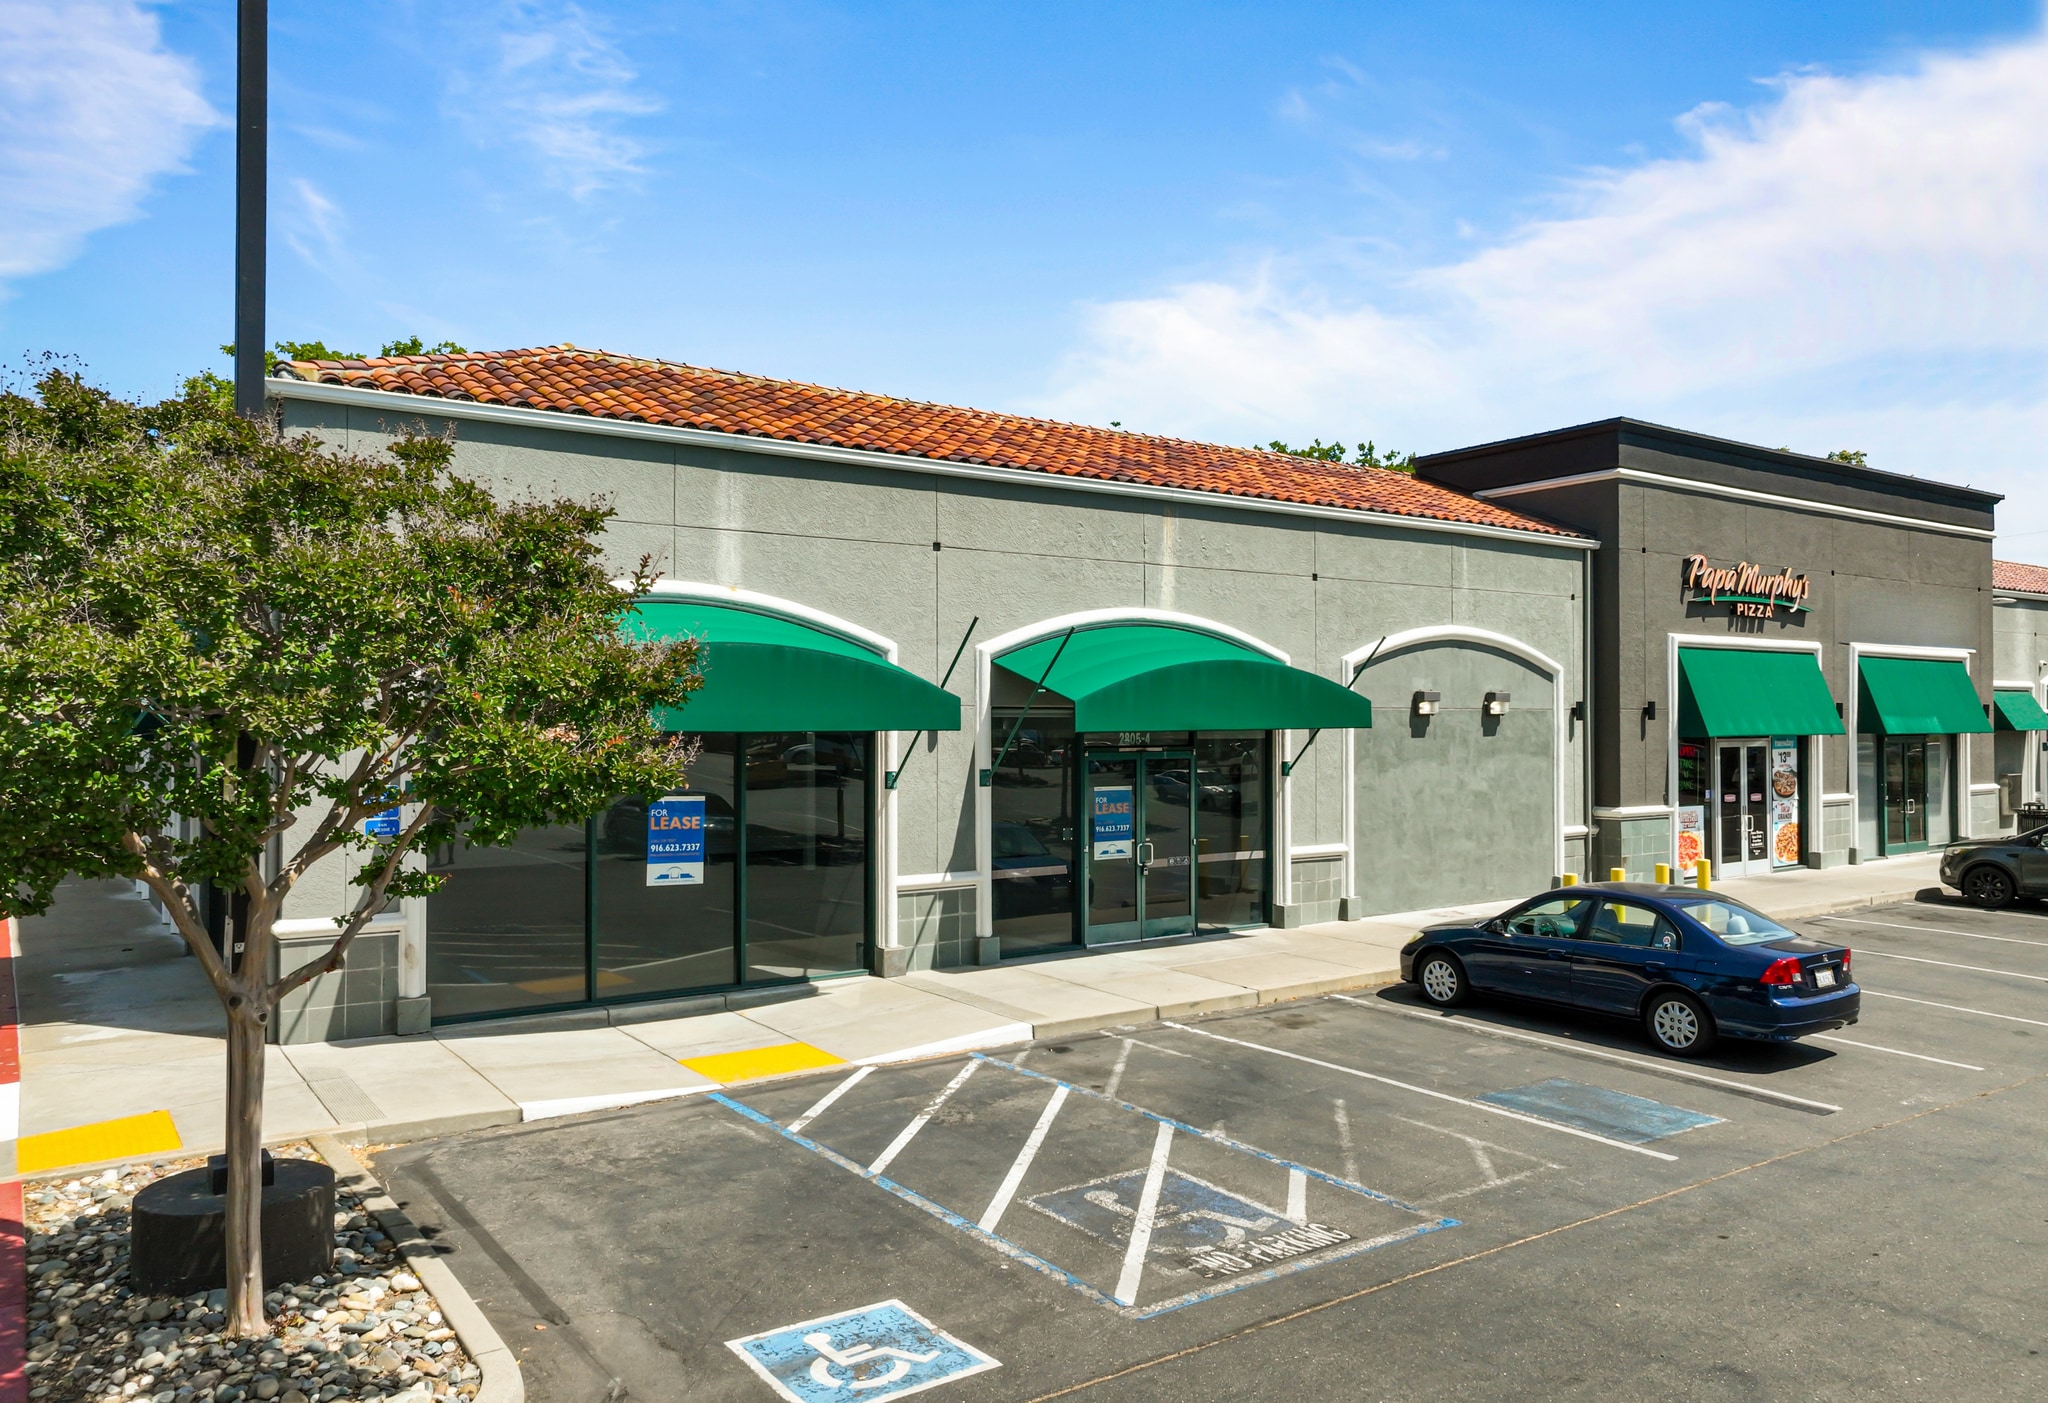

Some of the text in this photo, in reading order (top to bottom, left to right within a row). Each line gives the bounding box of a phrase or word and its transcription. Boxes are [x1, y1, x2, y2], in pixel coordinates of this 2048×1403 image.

[1690, 553, 1810, 613] Papa Murphy's
[1737, 603, 1773, 618] PIZZA
[1120, 732, 1150, 745] 2805-4
[1095, 802, 1129, 815] LEASE
[650, 816, 701, 830] LEASE
[650, 843, 700, 852] 916.623.7337
[1191, 1223, 1351, 1277] NO PARKING
